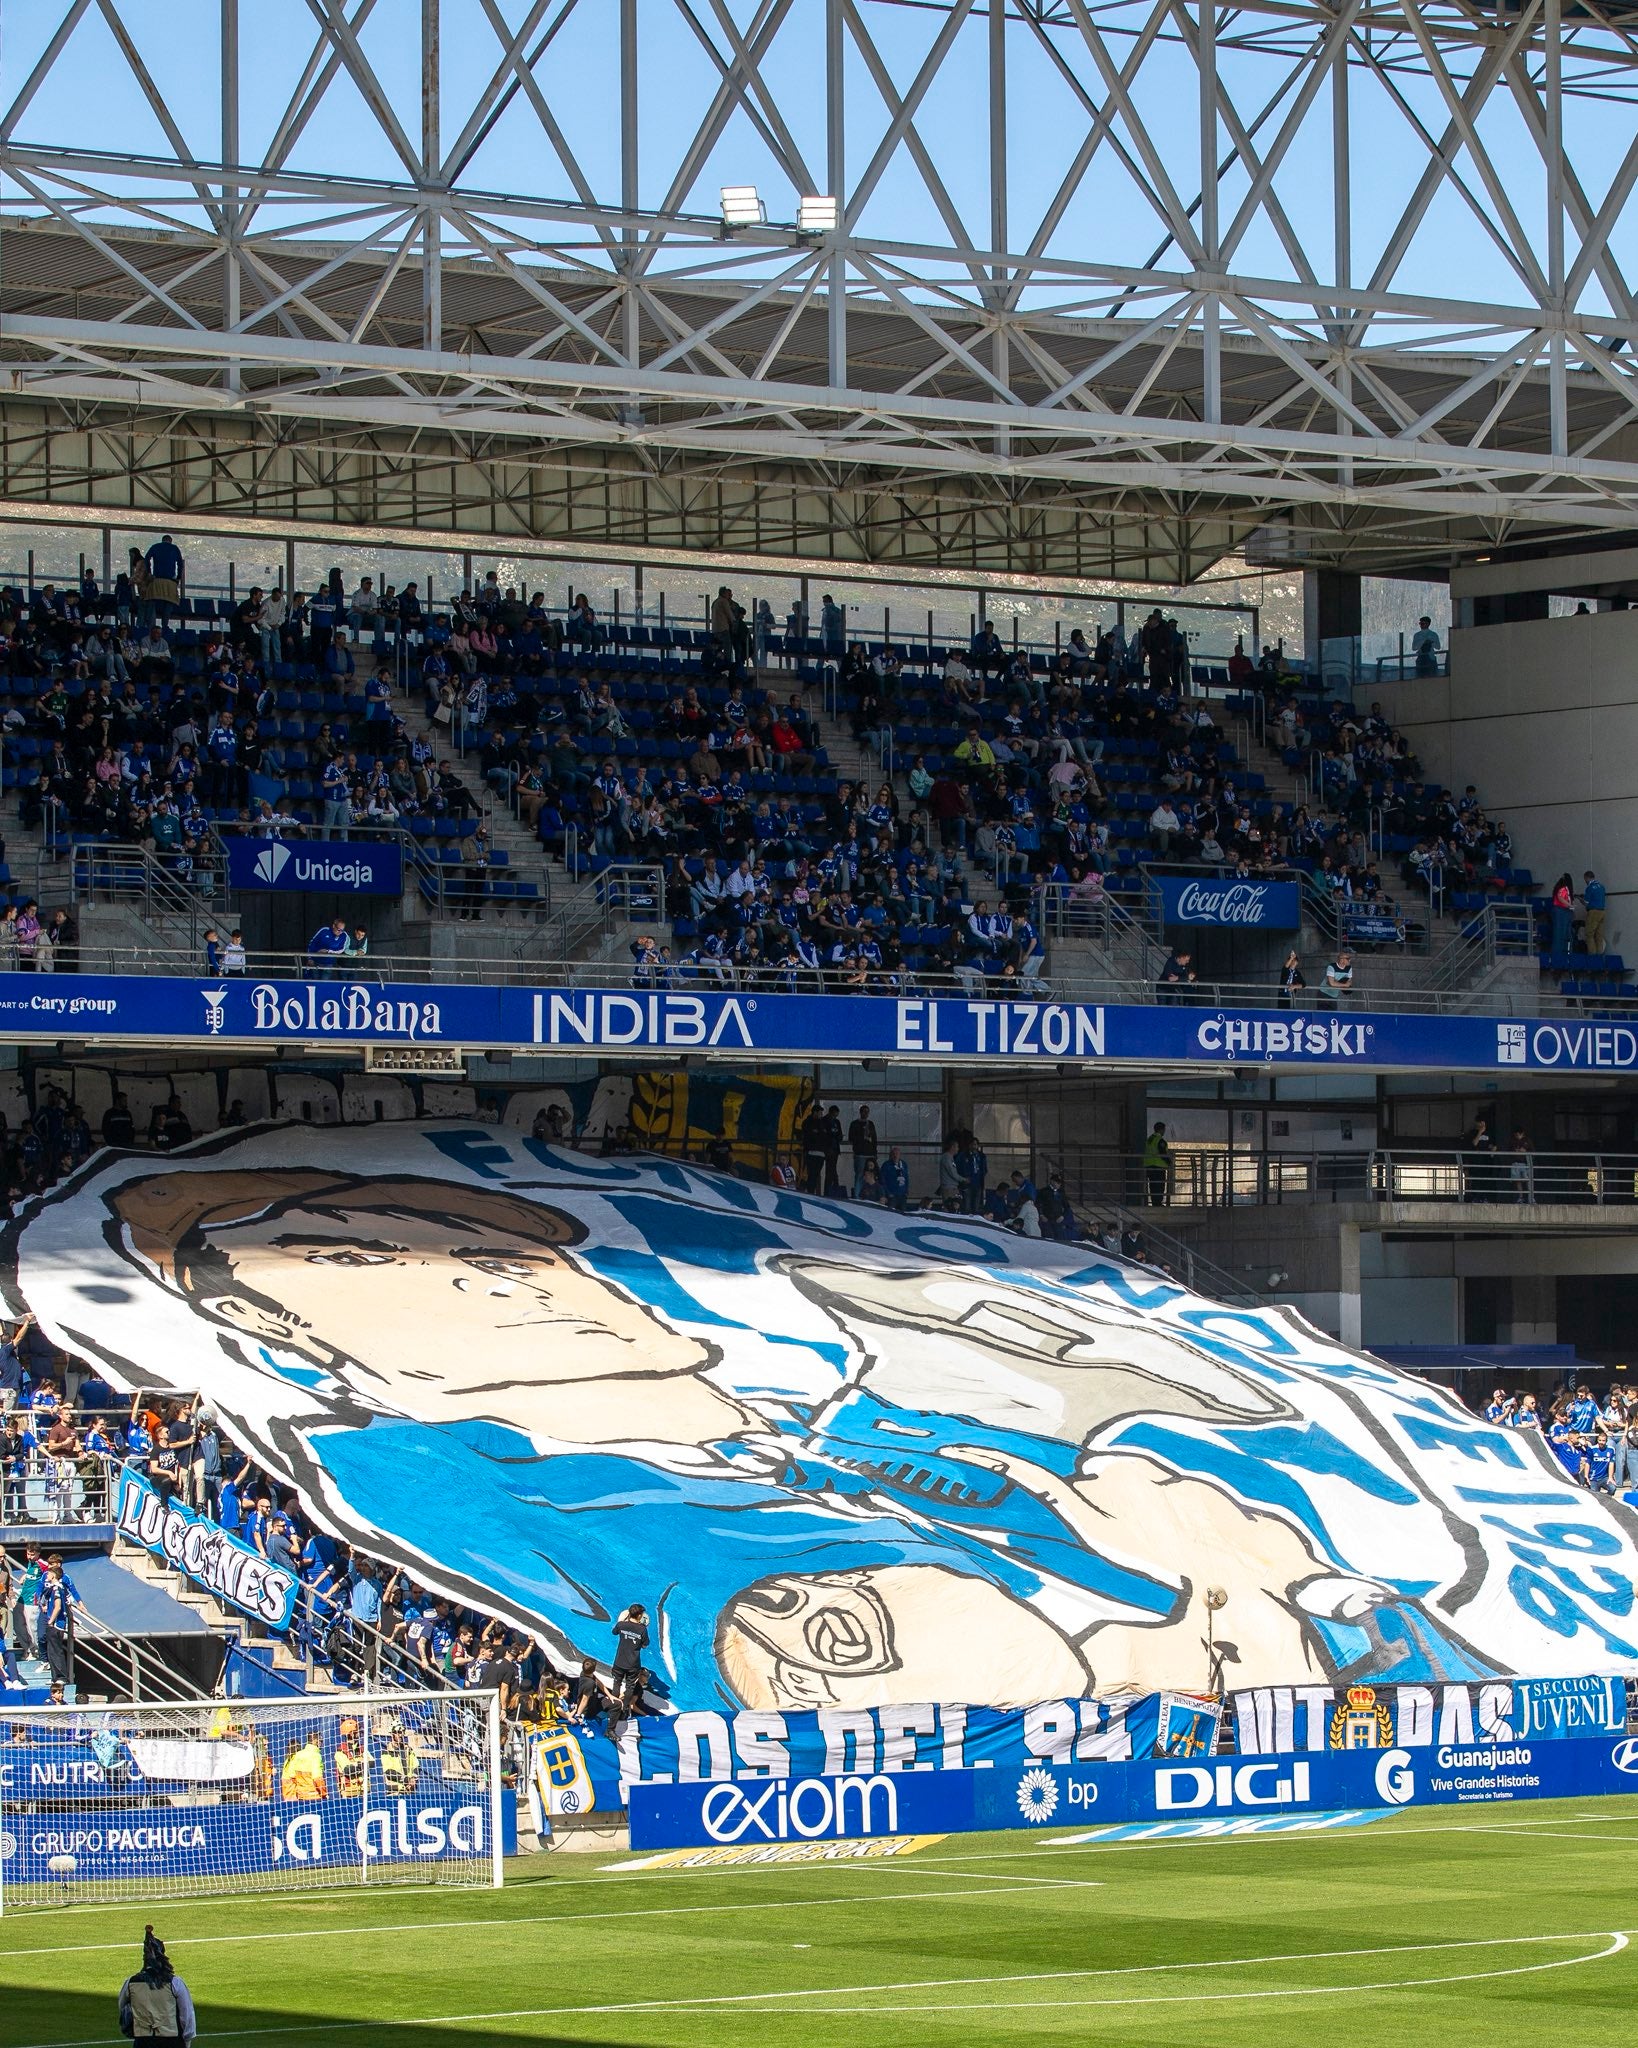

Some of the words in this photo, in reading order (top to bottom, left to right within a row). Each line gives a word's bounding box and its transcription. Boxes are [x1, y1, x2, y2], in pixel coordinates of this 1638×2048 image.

[295, 858, 373, 889] Unicaja
[1178, 881, 1267, 924] Coca-Cola
[31, 996, 68, 1013] Cary
[70, 997, 117, 1014] group
[251, 983, 443, 1040] BolaBana
[897, 1001, 953, 1051] EL
[1533, 1026, 1637, 1066] OVIED
[1533, 1677, 1600, 1697] SECCION
[1518, 1678, 1625, 1740] JUVENIL
[618, 1710, 791, 1785] LOS
[817, 1703, 994, 1776] DEL
[1438, 1745, 1531, 1771] Guanajuato
[1067, 1777, 1099, 1810] bp
[1155, 1761, 1311, 1811] DIGI
[1431, 1778, 1453, 1791] Vive
[1454, 1776, 1496, 1790] Grandes
[1497, 1774, 1540, 1788] Historias
[356, 1799, 484, 1856] alsa
[702, 1775, 898, 1843] exiom
[32, 1830, 102, 1854] GRUPO
[108, 1825, 206, 1851] PACHUCA
[121, 1854, 166, 1863] NEGOCIOS
